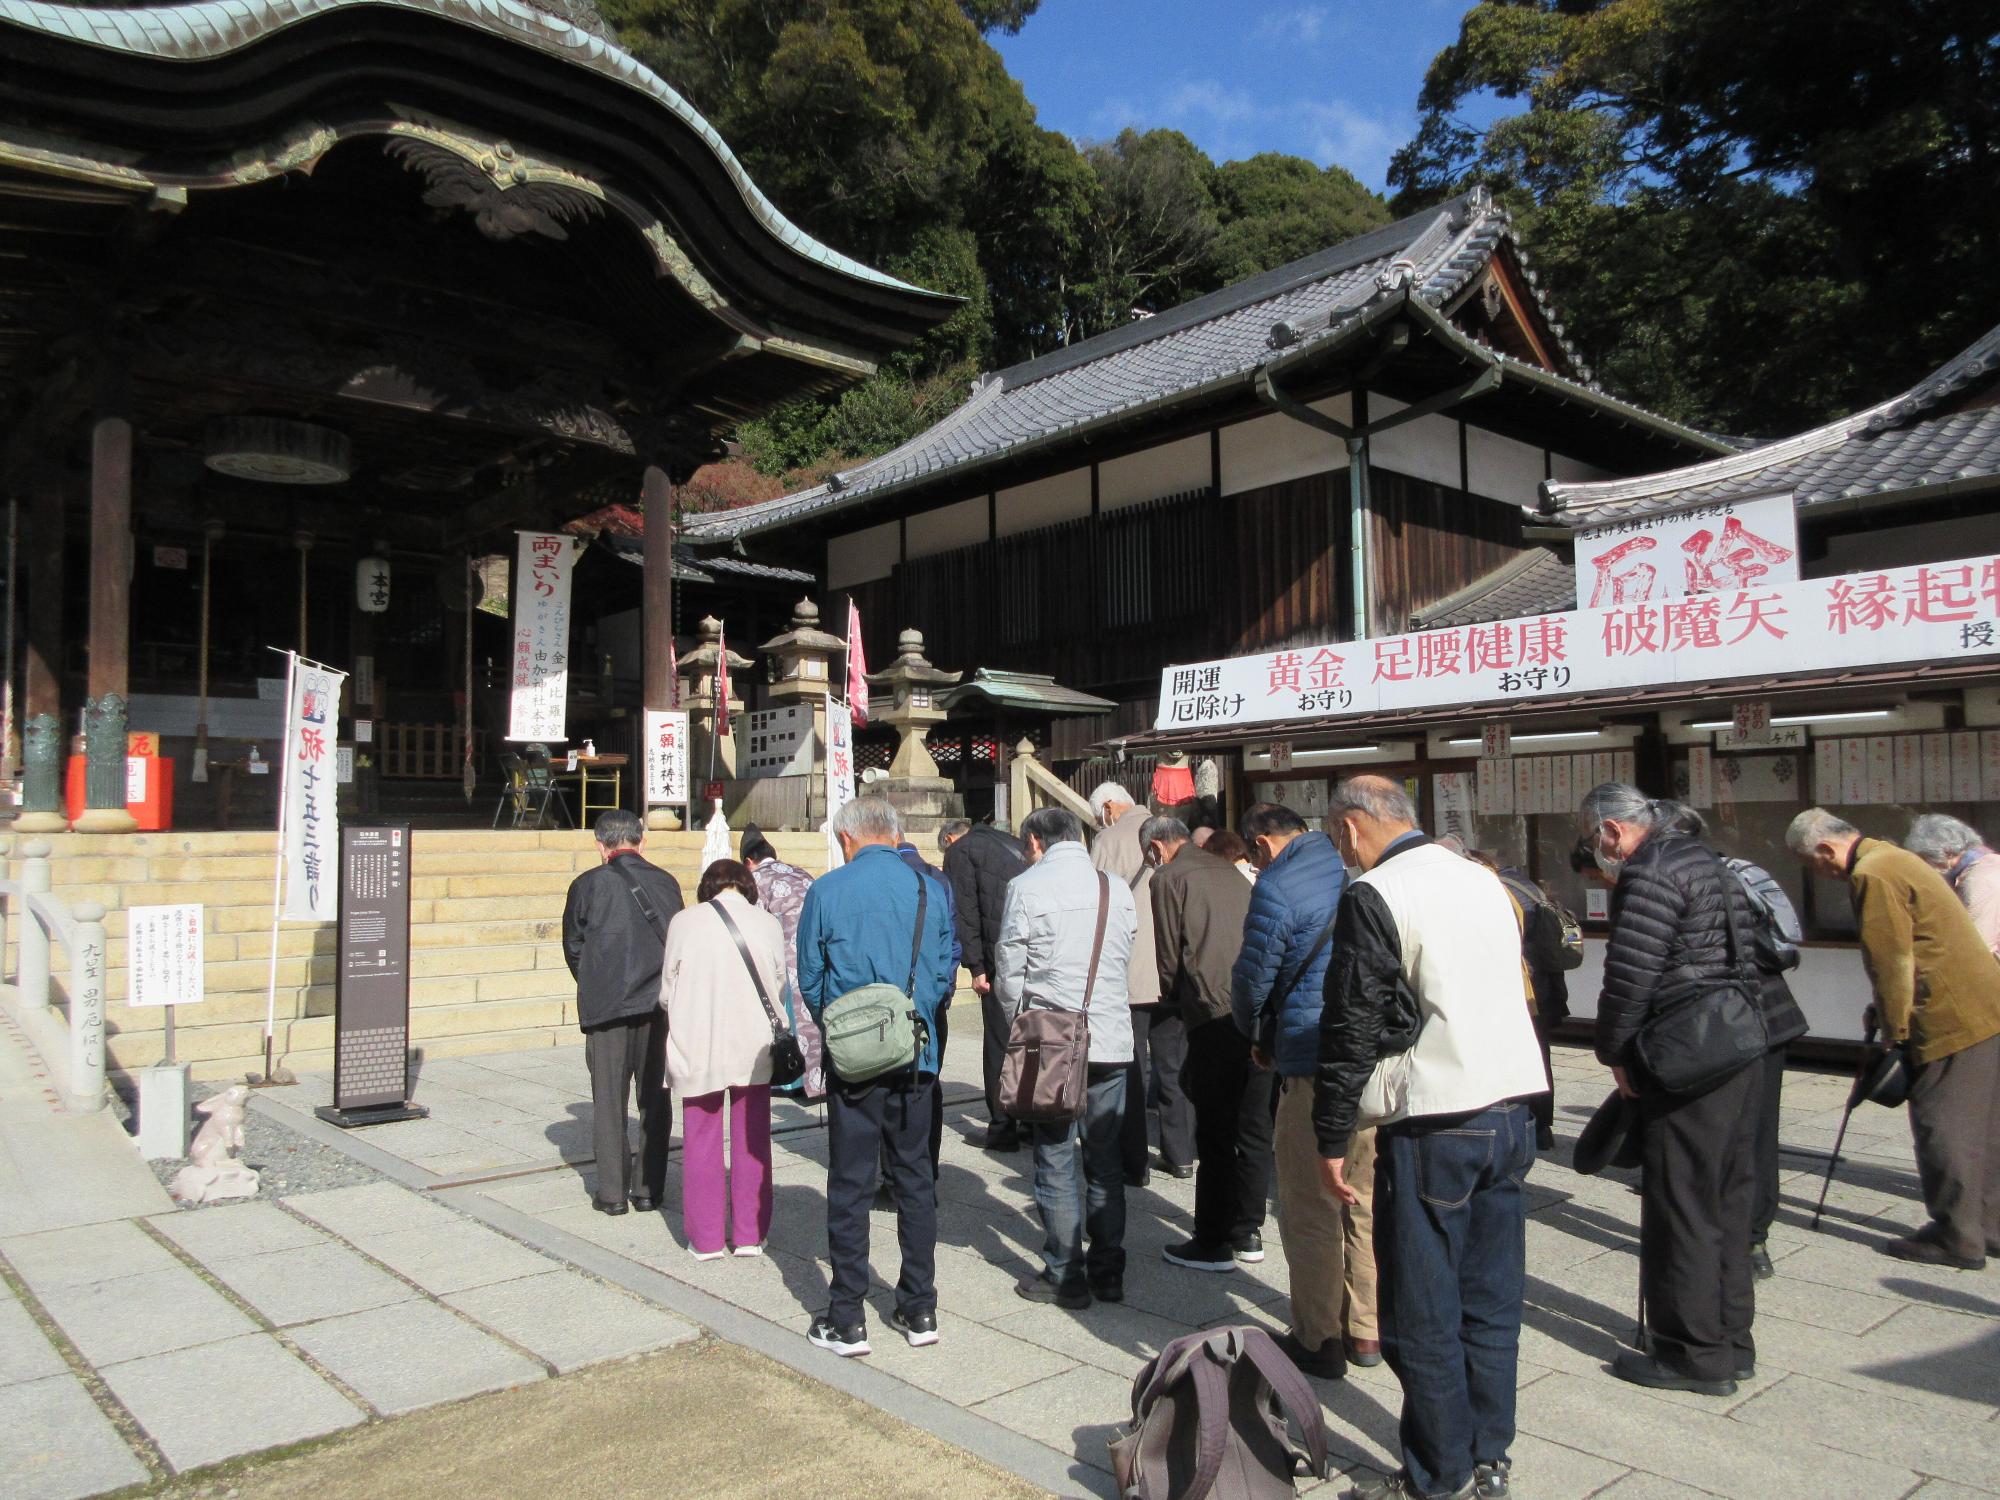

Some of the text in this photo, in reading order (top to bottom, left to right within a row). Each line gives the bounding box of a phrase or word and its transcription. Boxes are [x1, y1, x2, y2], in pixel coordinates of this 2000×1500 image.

[532, 536, 561, 598] 両まいり
[369, 571, 389, 606] 本宮
[1601, 591, 1789, 657] 破魔矢
[1371, 617, 1568, 684] 足腰健康
[1173, 666, 1221, 695] 開運
[1266, 648, 1346, 697] 黄金
[1498, 666, 1571, 693] お守り
[1171, 693, 1245, 722] 厄除け
[1298, 689, 1352, 711] お守り
[1737, 703, 1750, 741] お守り
